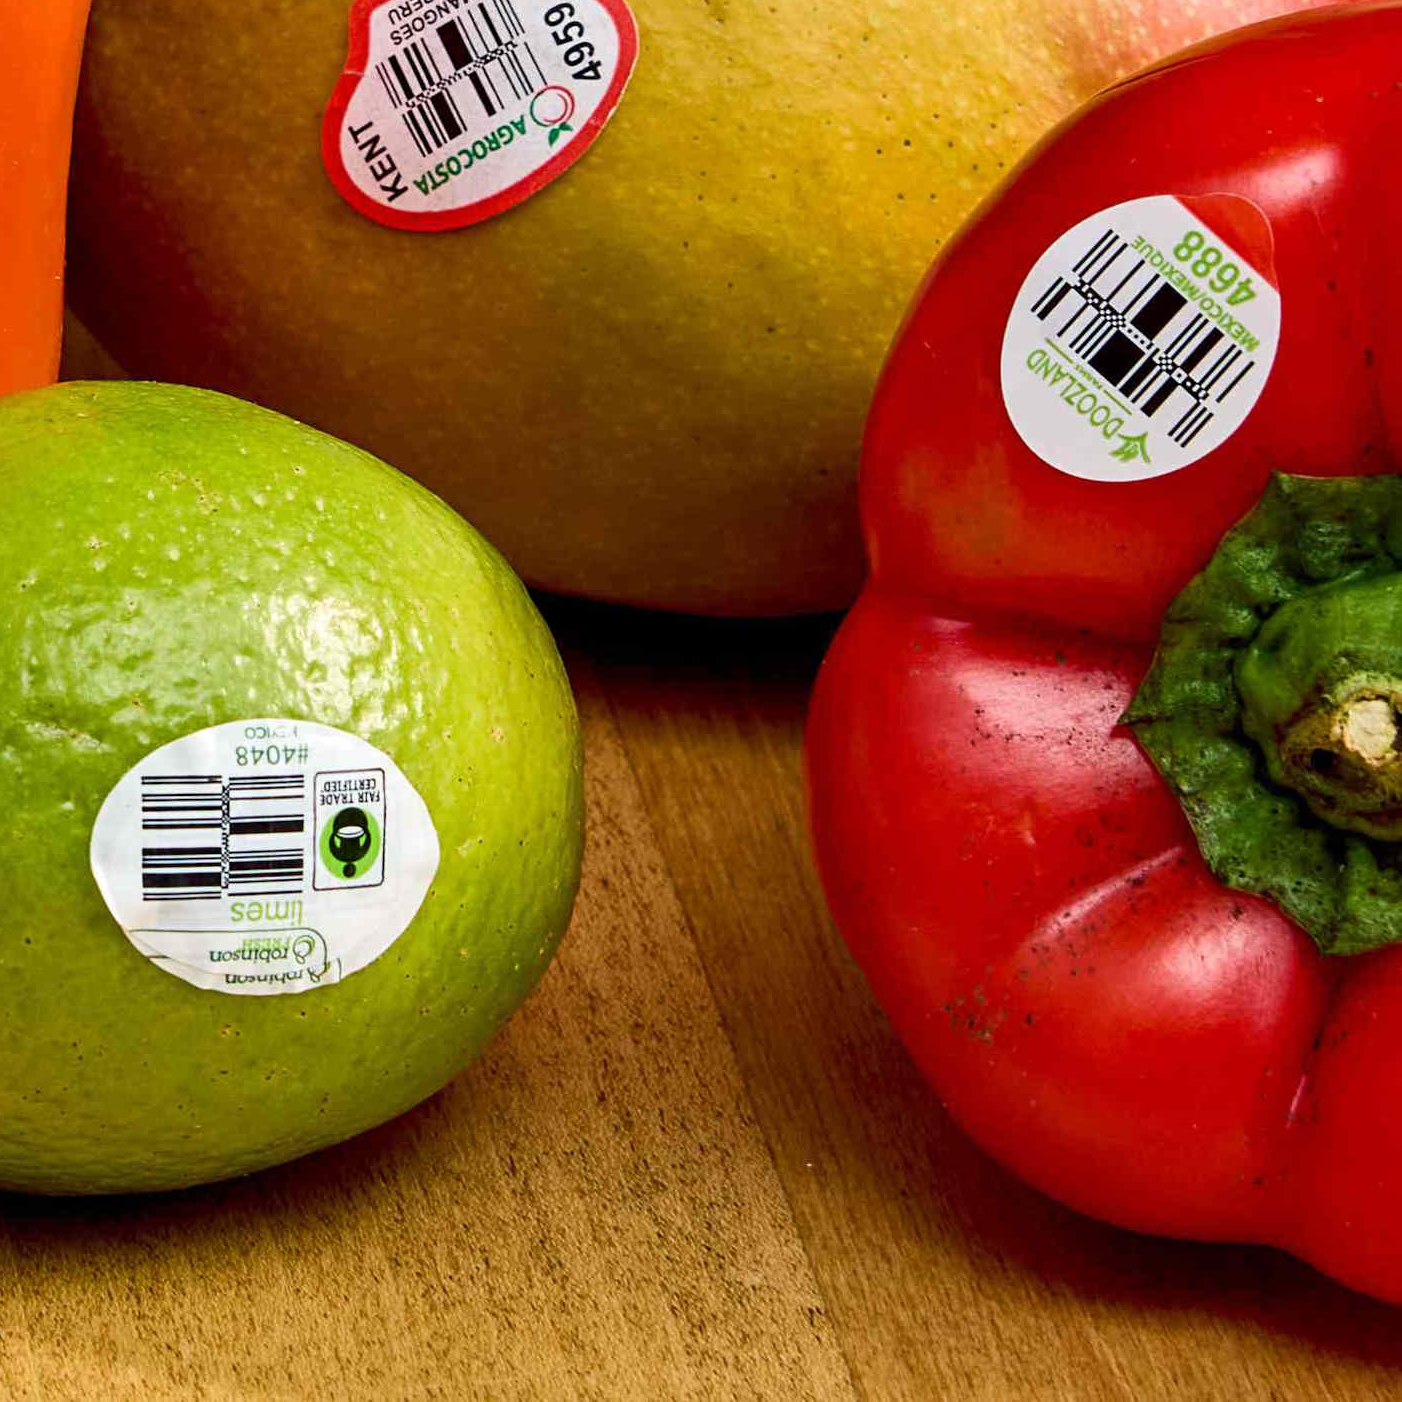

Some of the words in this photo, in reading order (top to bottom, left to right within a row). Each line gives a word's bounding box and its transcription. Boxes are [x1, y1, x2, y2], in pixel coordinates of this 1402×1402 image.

[544, 2, 602, 83] 4959
[349, 121, 408, 202] KENT
[413, 114, 527, 195] AGROCOSTA
[1131, 235, 1260, 353] MEXICO/MEXIQUE
[1173, 230, 1257, 308] 4688
[1026, 349, 1124, 439] DOOZLAND
[235, 744, 308, 766] #4048
[320, 793, 356, 806] TRADE
[323, 778, 377, 792] CERTIFIED
[358, 790, 380, 804] FAIR
[230, 899, 303, 926] limes
[209, 948, 288, 963] robinson
